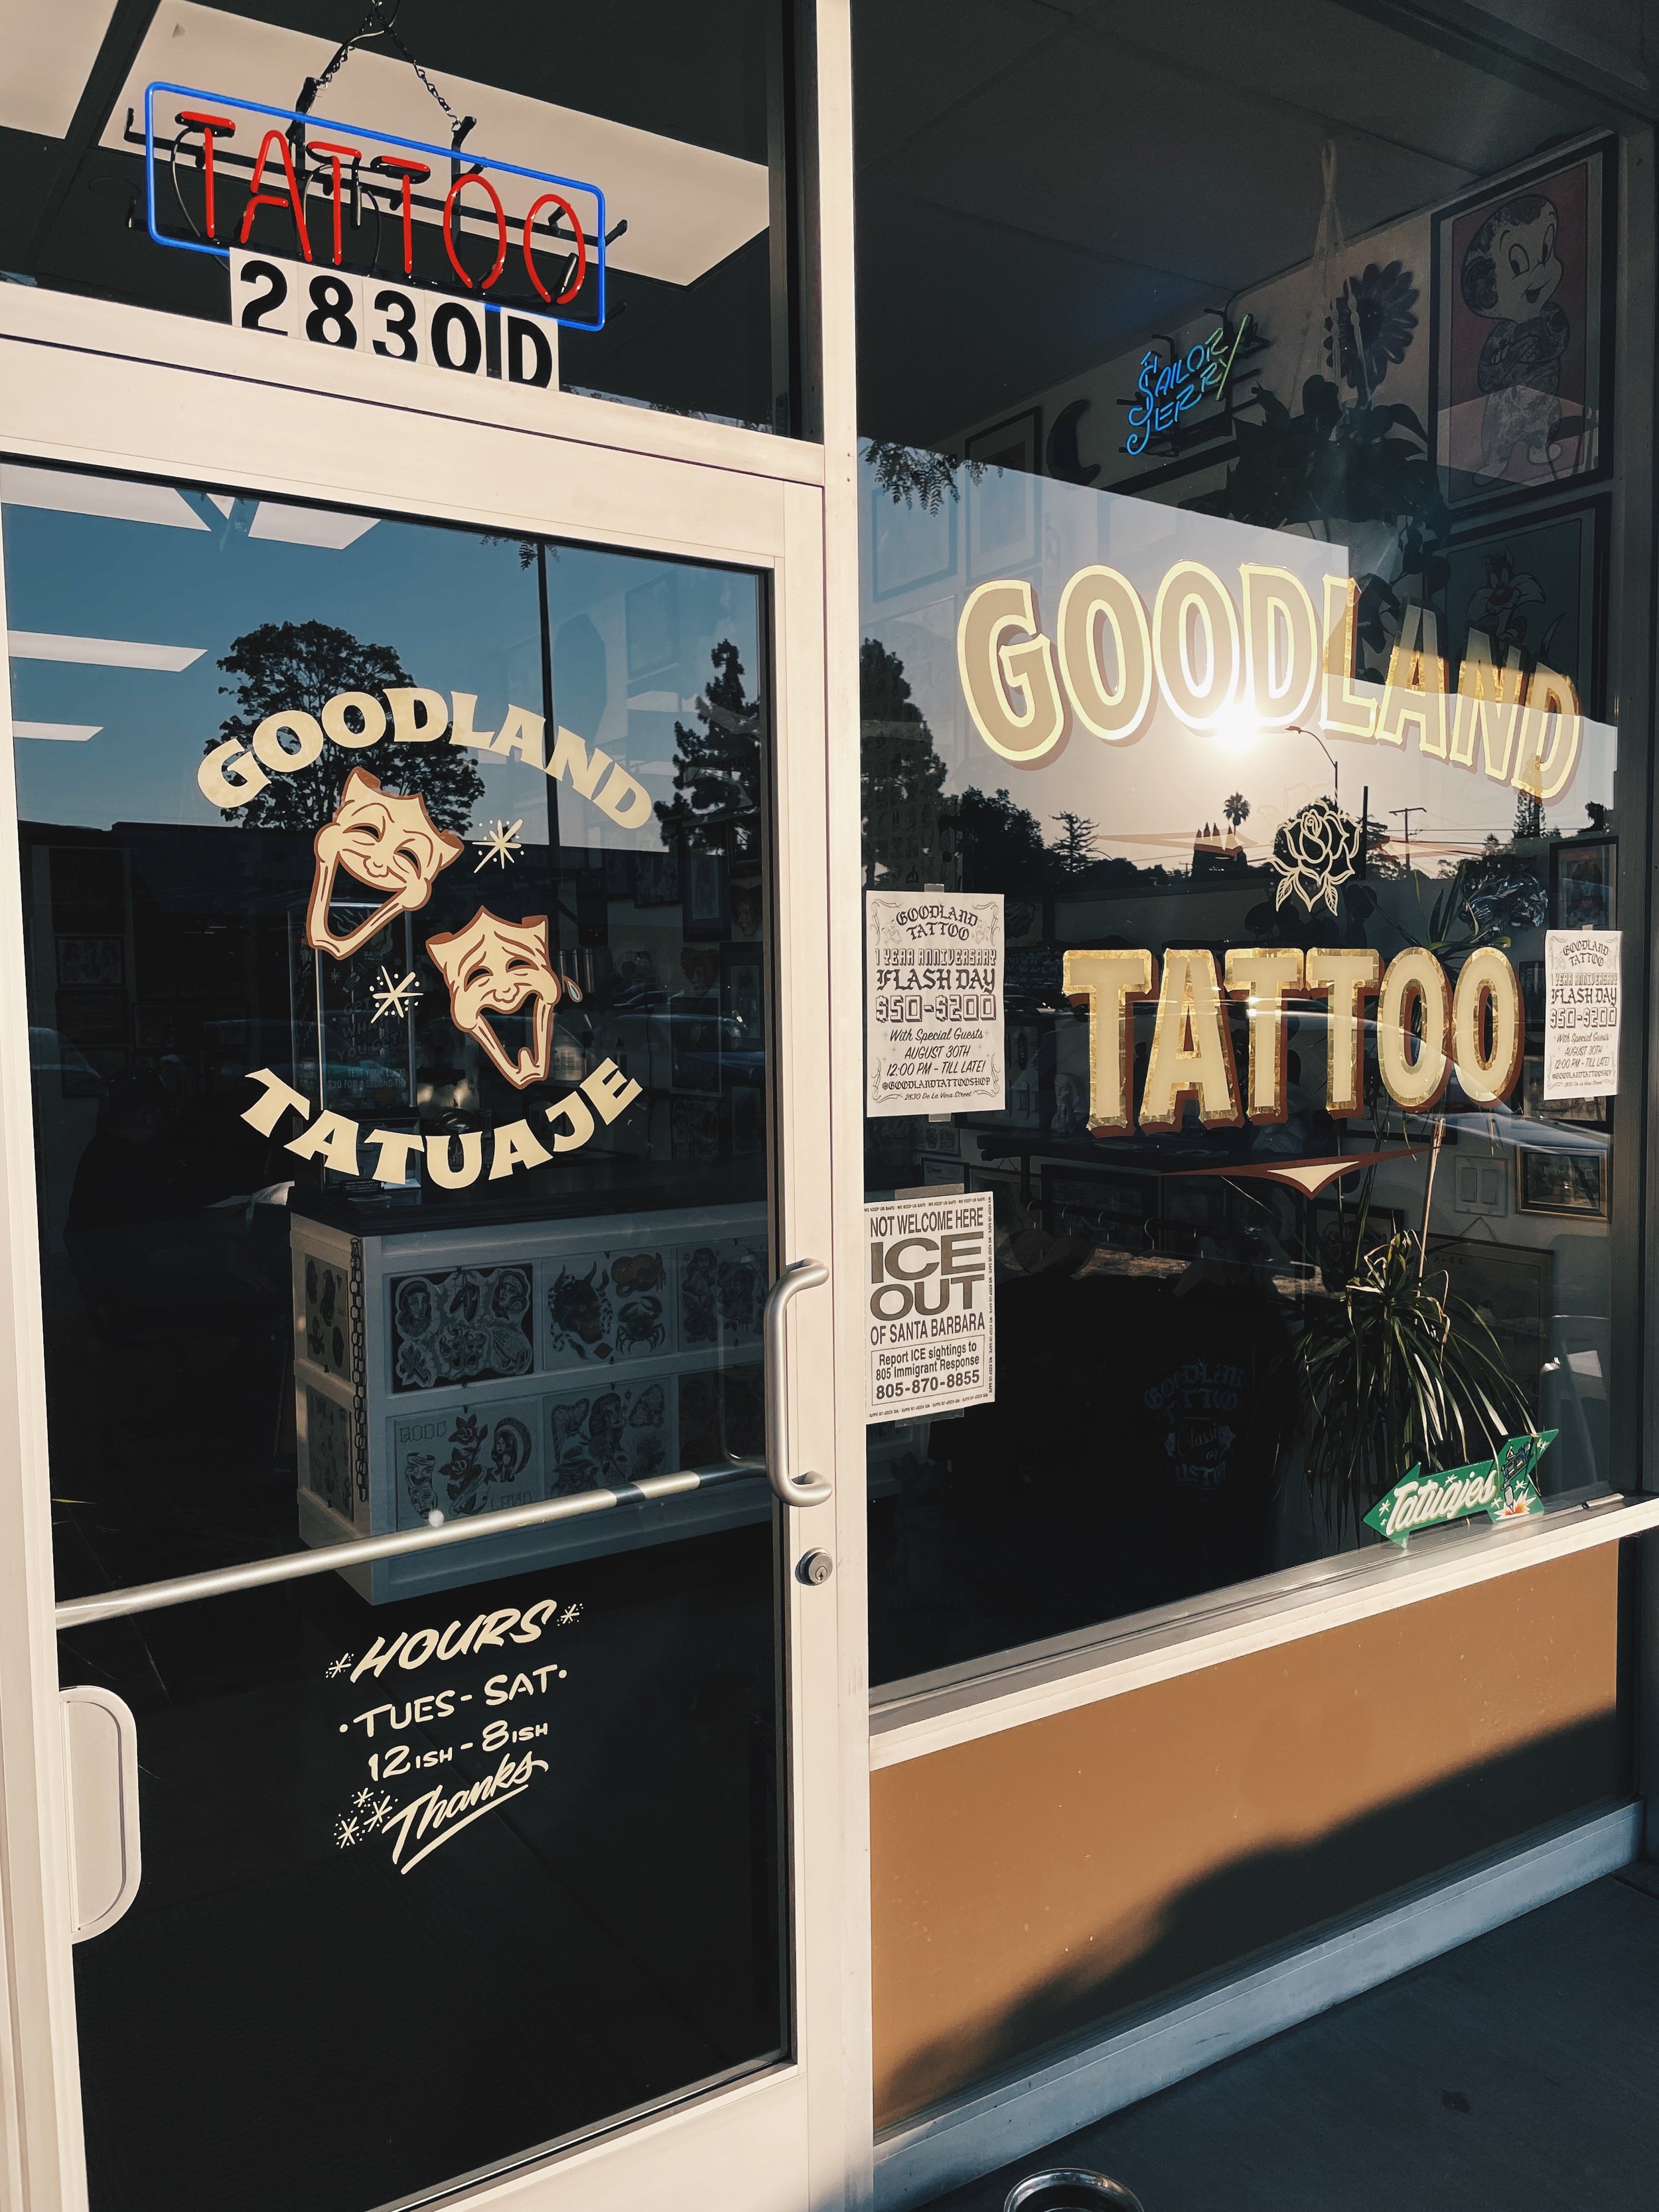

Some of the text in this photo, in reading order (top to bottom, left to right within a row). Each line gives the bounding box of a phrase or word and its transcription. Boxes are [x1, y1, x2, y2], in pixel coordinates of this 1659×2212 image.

[180, 110, 587, 305] TATTOO
[1126, 314, 1249, 455] JERRY
[1128, 327, 1228, 426] SAILOR
[958, 559, 1583, 800] GOODLAND
[196, 687, 653, 830] GOODLAND
[896, 904, 979, 927] GOODLAND
[906, 921, 970, 941] TATTOO
[875, 948, 997, 966] 1 YEAR ANNIVERSARY
[1563, 940, 1609, 956] GOODLAND
[1569, 952, 1604, 967] TATTOO
[876, 968, 995, 995] FLASH DAY
[1555, 973, 1573, 986] YEAR
[343, 997, 371, 1015] GET
[875, 994, 997, 1023] $50-$200
[1551, 988, 1593, 1005] FLASH
[1550, 1006, 1617, 1029] $50-$200
[337, 1030, 403, 1062] YOU GET!
[890, 1027, 983, 1044] With Special Guests
[1062, 947, 1524, 1138] TATTOO
[1557, 1033, 1570, 1043] With
[1571, 1032, 1593, 1044] Special
[904, 1044, 971, 1060] AUGUST 30TH
[1565, 1045, 1603, 1057] AUGUST 30TH
[348, 1069, 364, 1078] TEST
[366, 1069, 384, 1078] YOUR
[887, 1063, 914, 1076] 12:00
[916, 1062, 932, 1075] PM
[941, 1061, 959, 1074] TILL
[961, 1060, 986, 1074] LATE!
[328, 1080, 342, 1089] $20
[344, 1080, 358, 1088] FOR
[359, 1079, 365, 1088] A
[366, 1079, 392, 1088] SECOND
[882, 1077, 991, 1090] @GOODLANDTATTOOSHOP
[240, 1057, 644, 1189] TATUAJE
[870, 1207, 983, 1237] NOT WELCOME HERE
[871, 1231, 985, 1284] ICE
[870, 1274, 985, 1321] OUT
[871, 1311, 985, 1346] OF SANTA BARBARA
[876, 1355, 979, 1381] 805 Immigrant Response
[879, 1341, 977, 1368] Report ICE sightings to
[876, 1369, 980, 1400] 805-870-8855
[1386, 1469, 1498, 1536] Tatuajes
[350, 1599, 557, 1683] HOURS
[381, 1750, 549, 1866] Thanks
